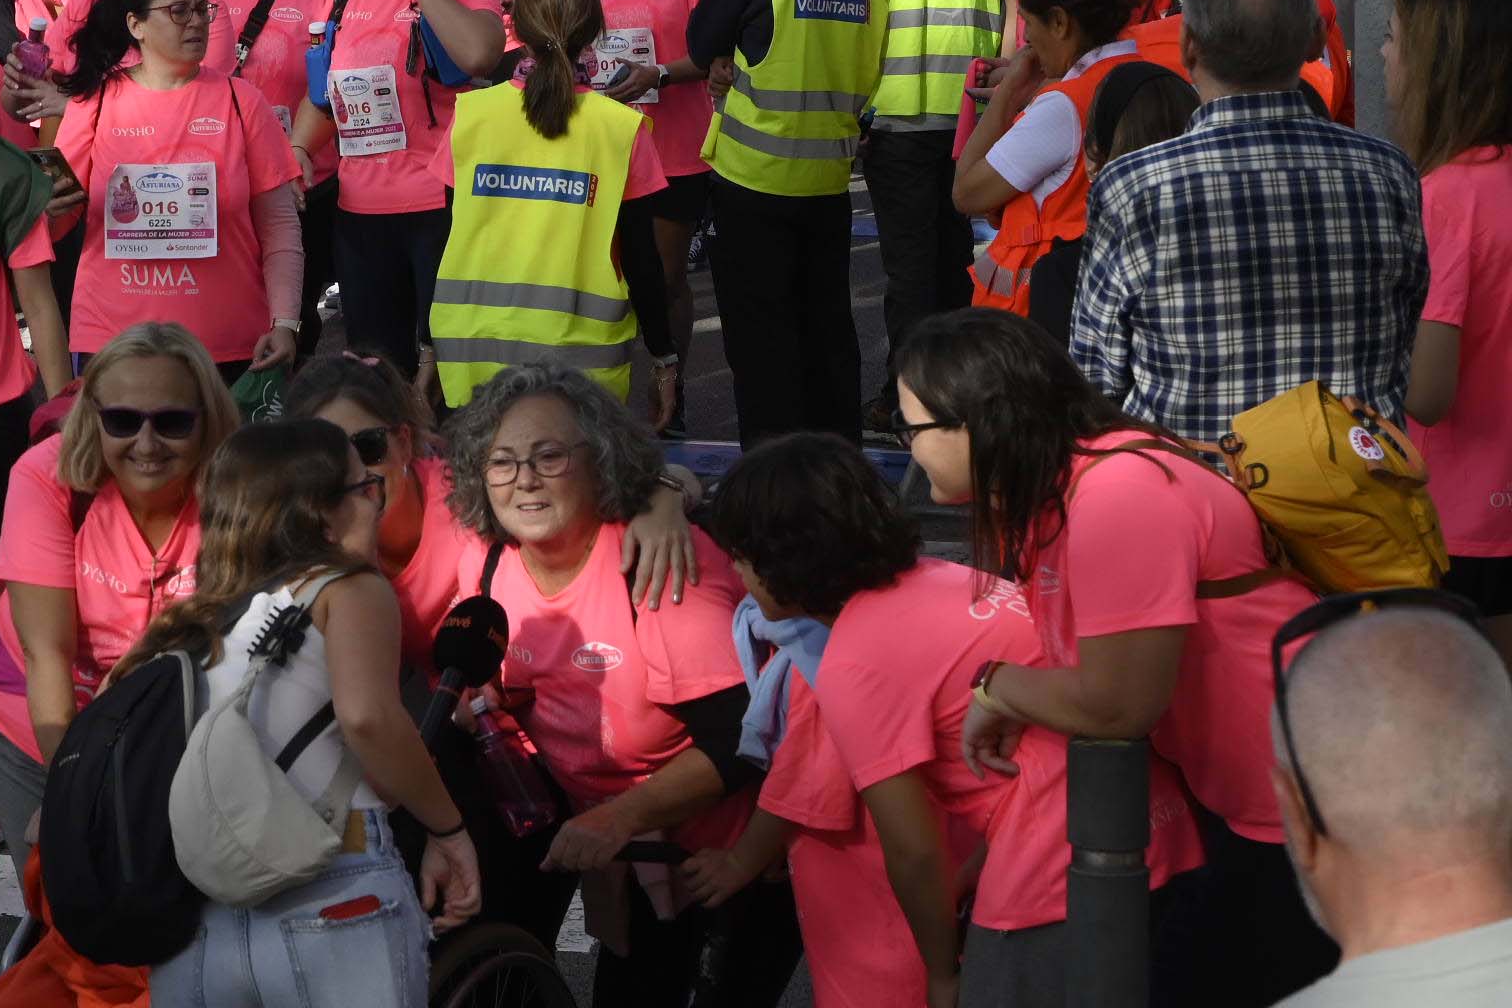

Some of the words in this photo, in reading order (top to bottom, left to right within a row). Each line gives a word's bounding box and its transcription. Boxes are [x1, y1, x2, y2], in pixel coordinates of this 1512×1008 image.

[112, 126, 155, 137] OYSHO
[140, 180, 181, 189] ASTURIANA
[476, 172, 585, 195] VOLUNTARIS
[142, 201, 179, 215] 016
[148, 219, 172, 228] 6225
[115, 244, 148, 252] OYSHO
[120, 263, 197, 287] SUMA
